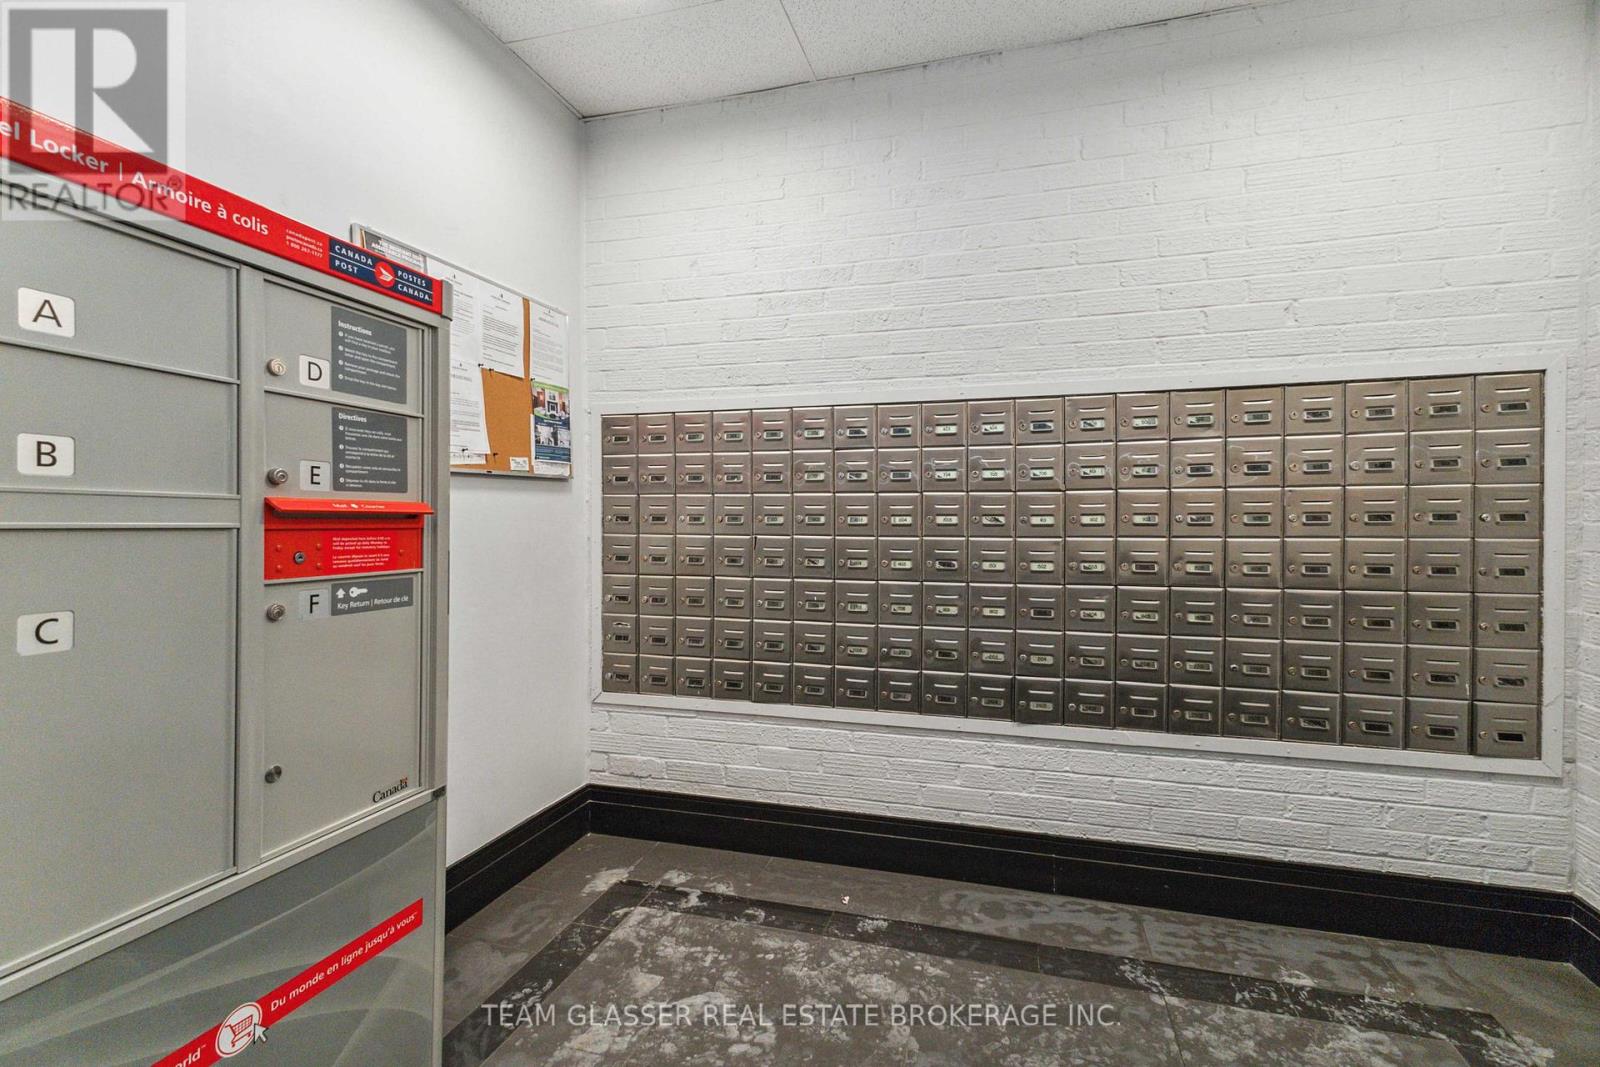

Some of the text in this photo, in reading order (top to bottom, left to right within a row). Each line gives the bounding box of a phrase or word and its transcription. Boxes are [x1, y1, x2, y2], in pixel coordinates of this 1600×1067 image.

[30, 128, 109, 174] Locker
[132, 171, 269, 236] Armoire à colis
[335, 244, 373, 266] CANADA
[335, 259, 358, 274] POST
[397, 270, 426, 287] POSTES
[32, 299, 62, 328] A
[338, 319, 372, 336] Instructions
[308, 361, 323, 382] D
[338, 412, 367, 423] Directives
[36, 441, 57, 467] B
[310, 466, 321, 485] E
[309, 594, 320, 614] F
[337, 602, 348, 610] Key
[349, 599, 369, 608] Return
[374, 597, 392, 605] Retour
[35, 618, 59, 645] C
[373, 778, 408, 803] Canada
[271, 998, 286, 1012] Du
[289, 973, 325, 1000] monde
[326, 963, 339, 976] en
[341, 947, 364, 966] ligne
